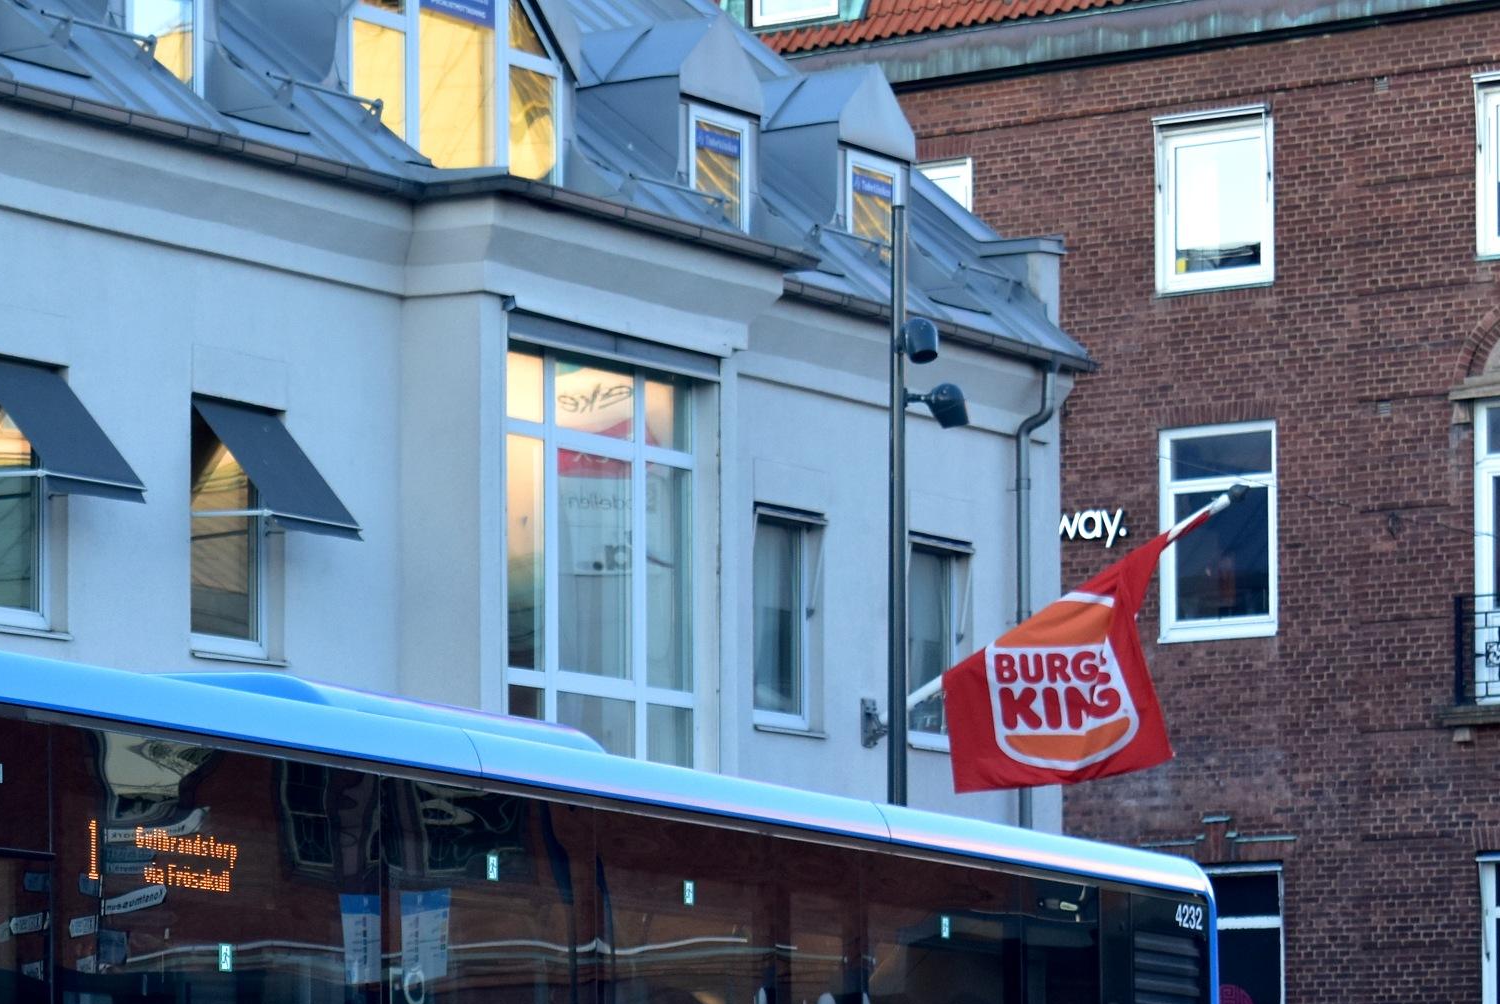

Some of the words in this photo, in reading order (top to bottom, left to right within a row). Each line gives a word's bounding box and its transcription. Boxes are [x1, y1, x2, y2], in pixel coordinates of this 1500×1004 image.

[994, 651, 1111, 685] BURG
[998, 685, 1121, 730] KING
[88, 819, 99, 880] 1
[135, 826, 238, 869] Gullbrandstorp
[143, 862, 165, 885] via
[168, 863, 230, 892] Frösakull
[1174, 904, 1203, 930] 4232
